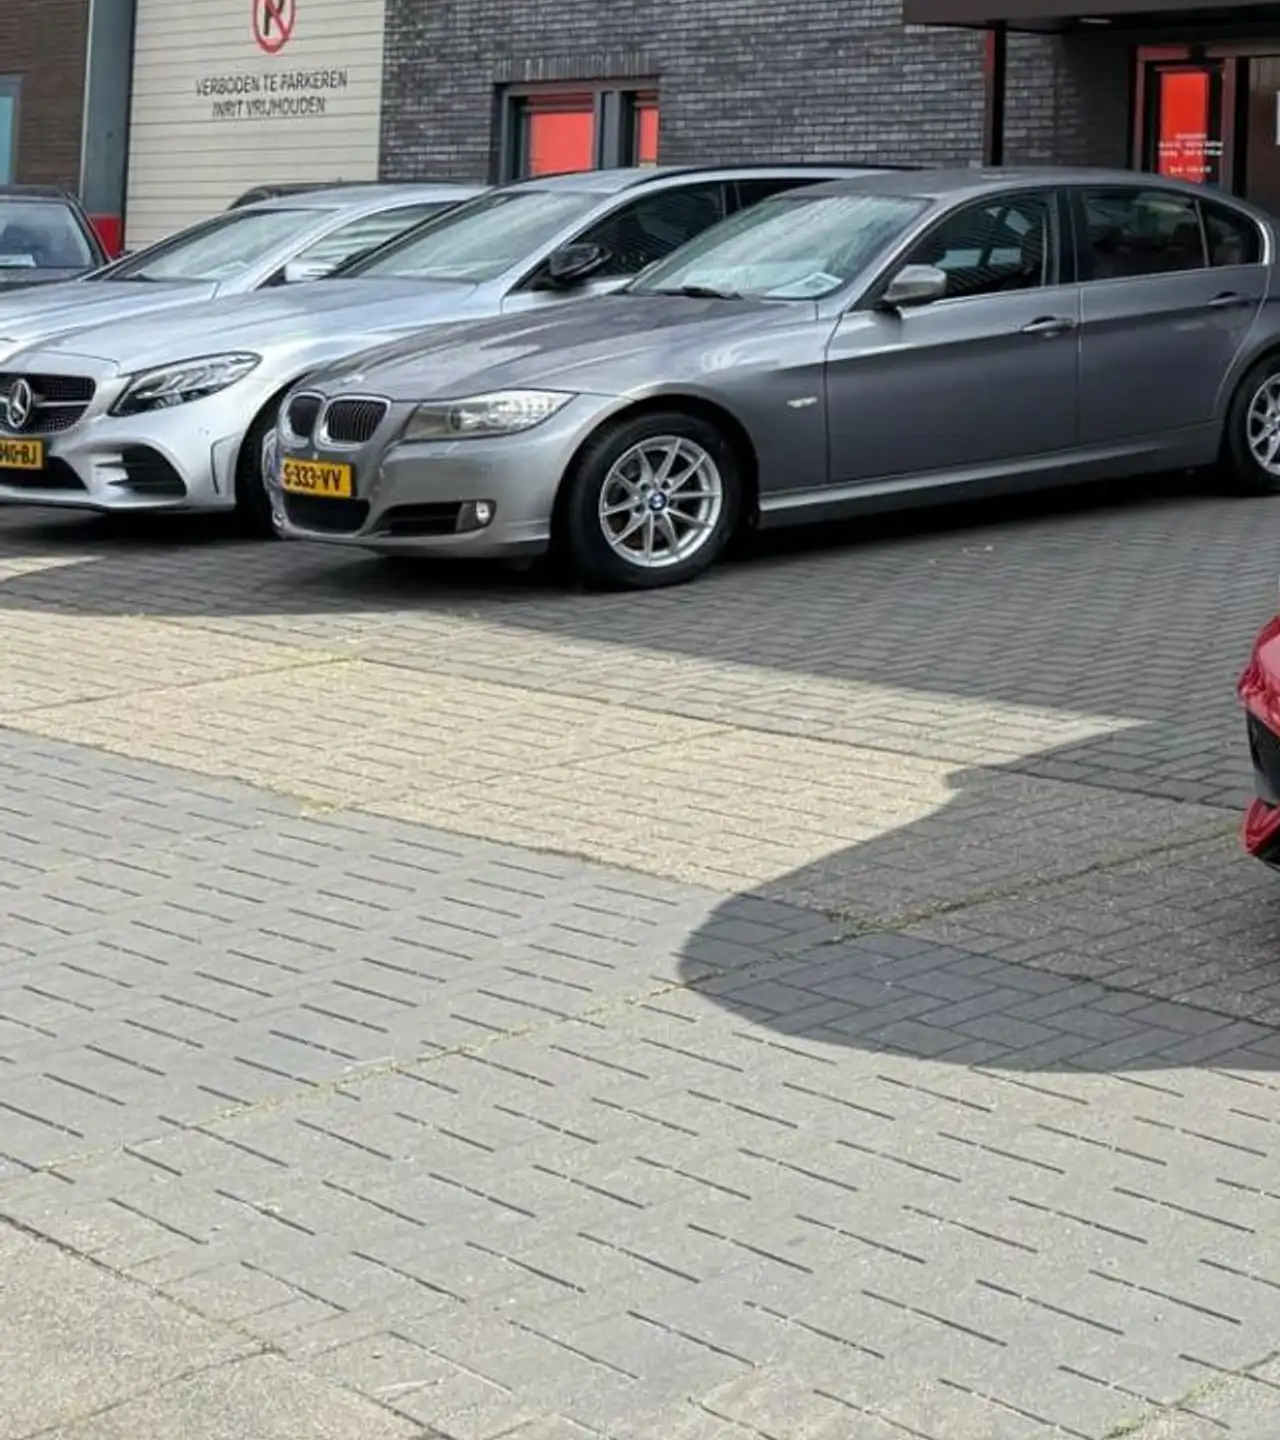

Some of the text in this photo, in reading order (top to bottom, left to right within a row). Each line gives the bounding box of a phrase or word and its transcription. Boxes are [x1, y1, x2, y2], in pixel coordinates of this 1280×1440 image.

[196, 69, 349, 96] VERBODEN TE PARKEREN
[246, 95, 327, 116] VRIJHOUDEN
